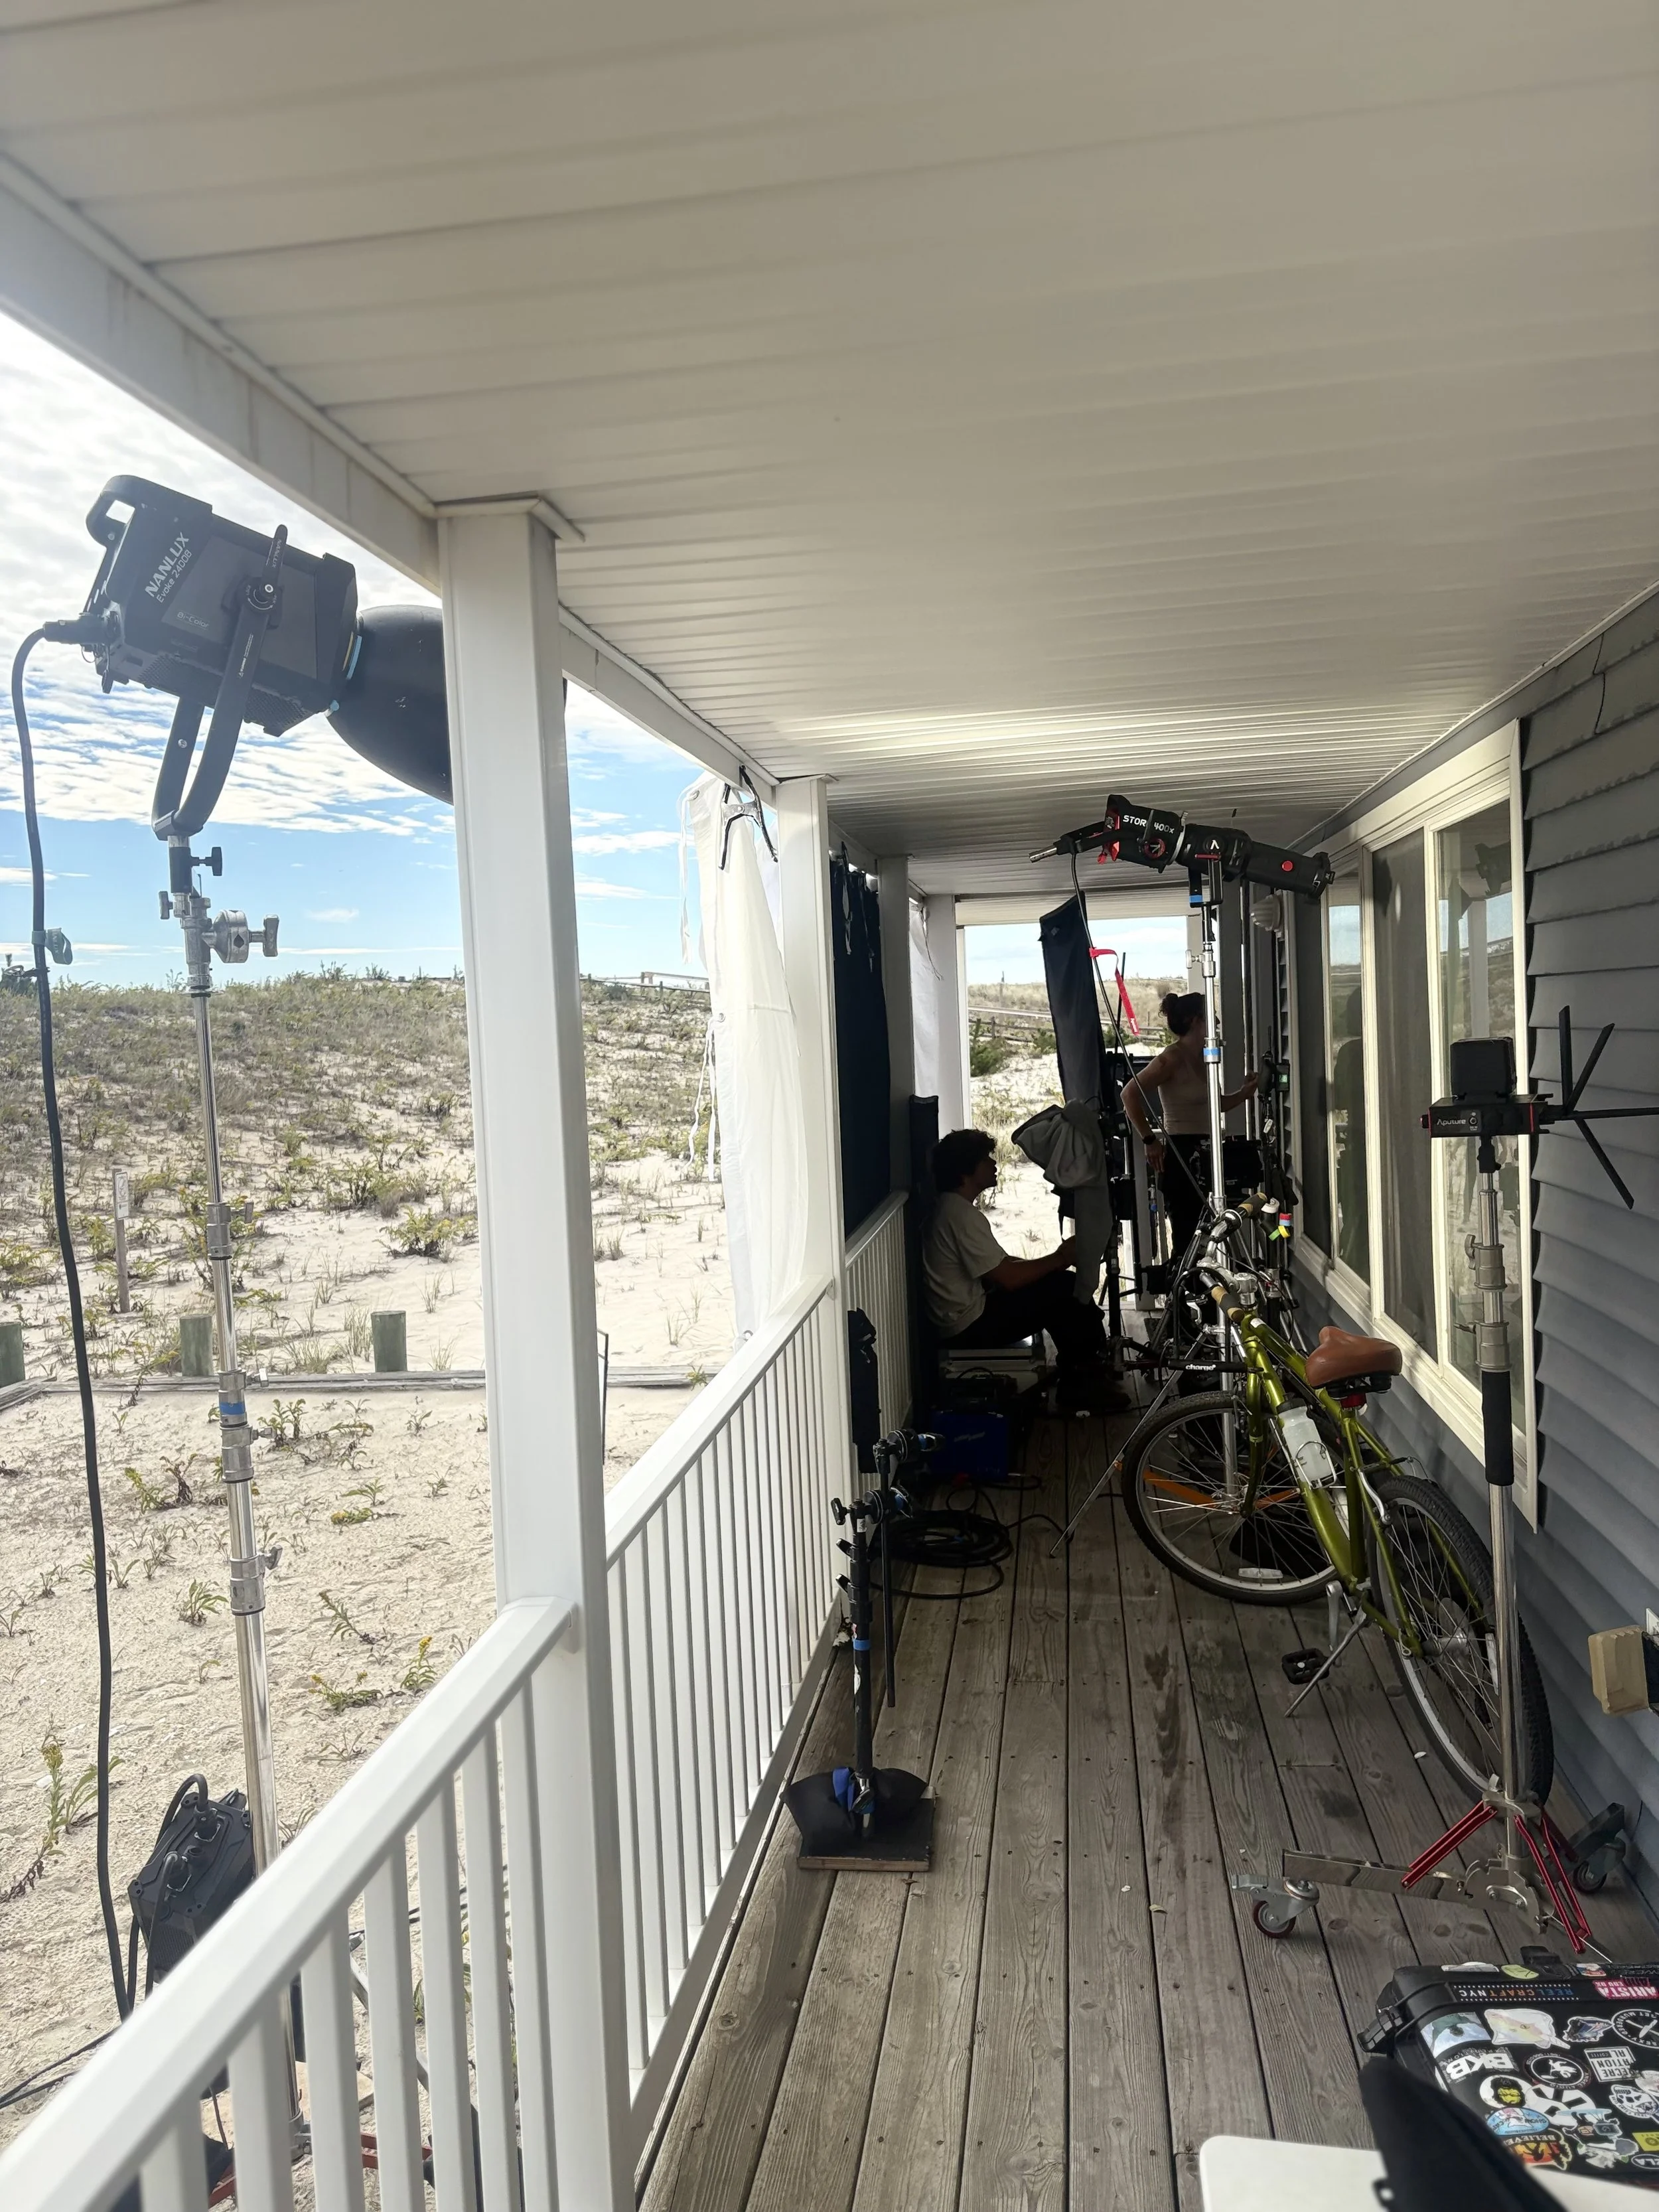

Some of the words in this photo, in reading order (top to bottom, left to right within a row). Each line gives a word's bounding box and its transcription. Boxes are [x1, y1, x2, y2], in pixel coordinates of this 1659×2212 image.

[145, 532, 189, 597] NANLUX
[157, 579, 175, 603] Evoke
[172, 550, 192, 578] 2400B
[177, 612, 209, 628] Bi-Color
[1123, 815, 1147, 827] STOR
[1597, 1986, 1656, 1997] ARISTA
[1616, 2012, 1636, 2035] MURDERED
[1446, 2053, 1514, 2080] BKB
[1597, 2058, 1630, 2067] ATION
[1577, 2072, 1589, 2088] ANGEL
[1504, 2134, 1556, 2145] BELIEVE
